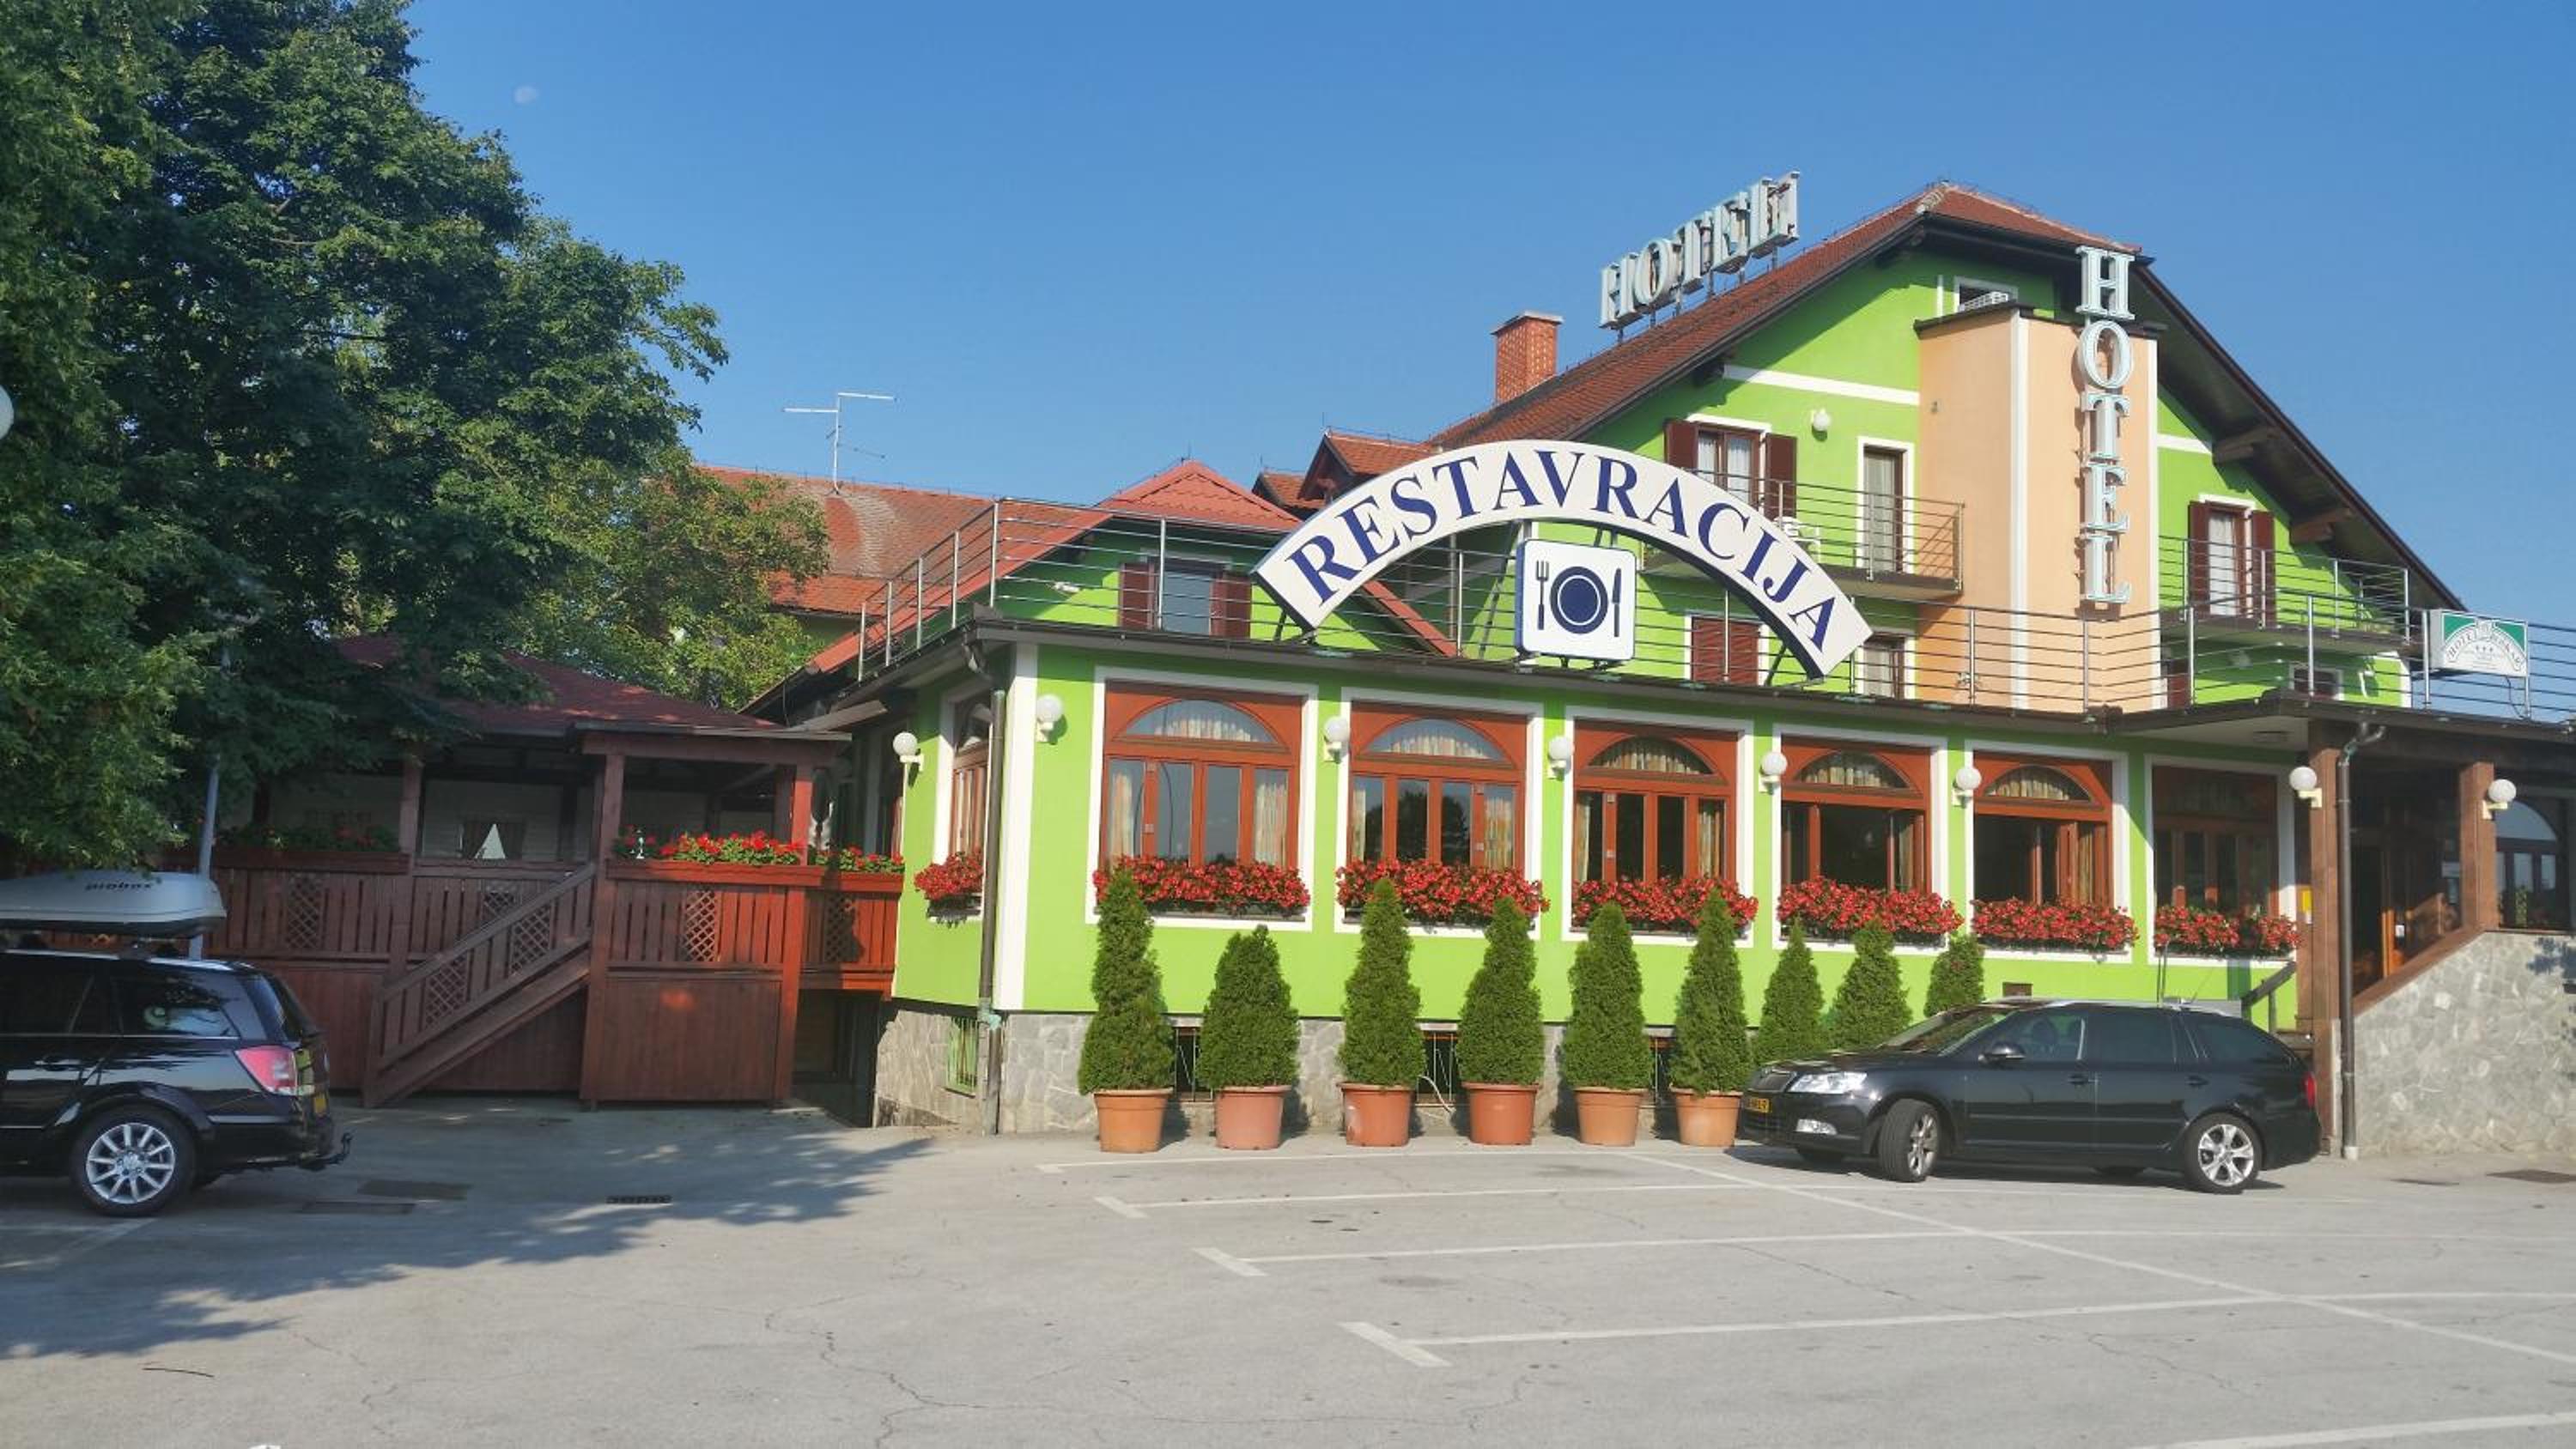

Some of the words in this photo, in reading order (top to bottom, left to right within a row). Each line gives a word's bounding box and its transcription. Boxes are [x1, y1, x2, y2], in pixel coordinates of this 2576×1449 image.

[1599, 172, 1800, 330] HOTEL
[2075, 245, 2135, 604] HOTEL
[1285, 451, 1838, 652] RESTAVRACIJA
